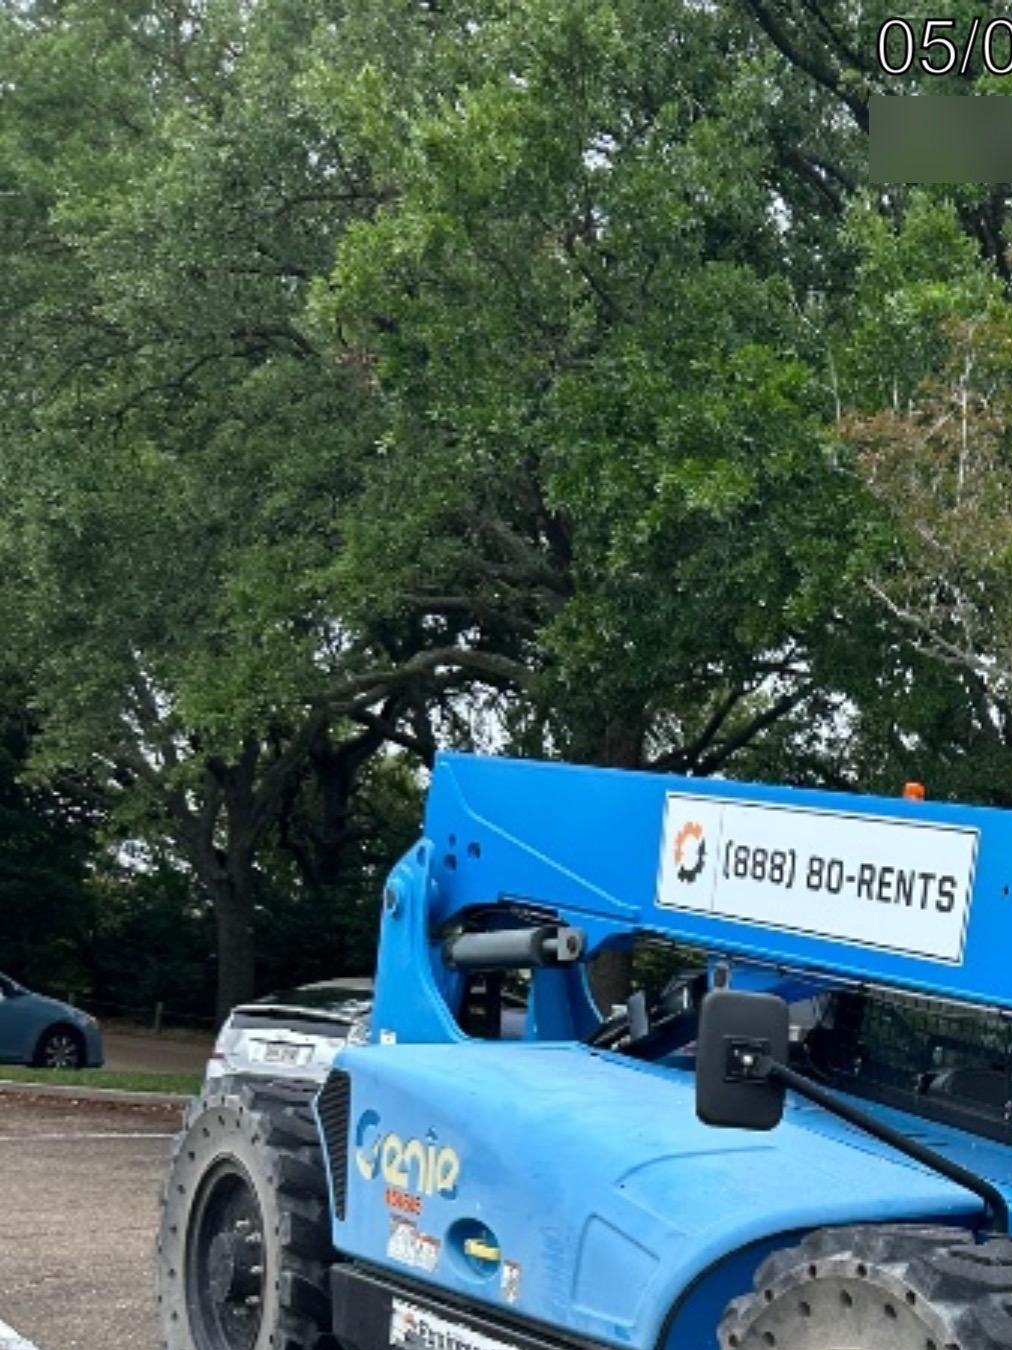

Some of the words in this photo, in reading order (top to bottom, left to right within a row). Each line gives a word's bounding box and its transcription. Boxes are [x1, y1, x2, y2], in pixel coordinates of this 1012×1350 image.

[722, 840, 796, 889] (888)
[805, 855, 958, 914] 80-RENTS
[356, 1109, 460, 1200] Genie
